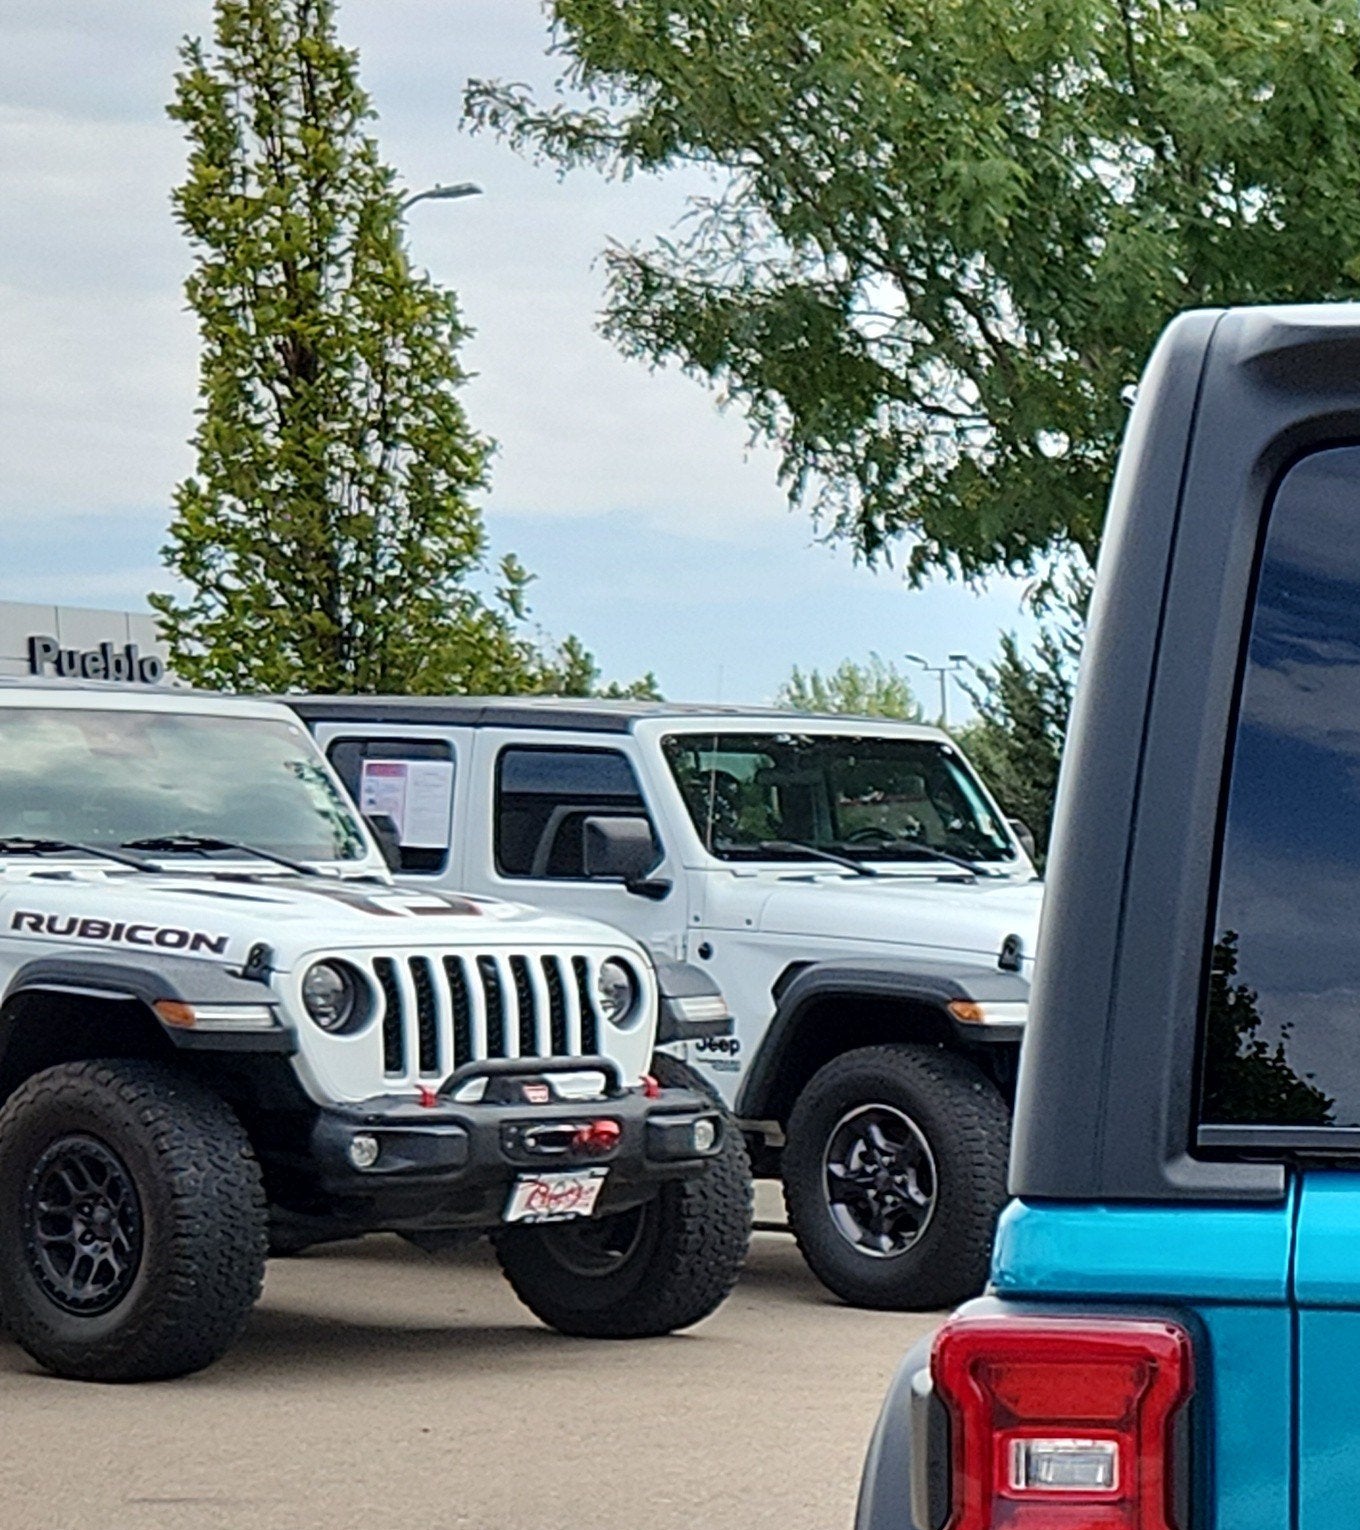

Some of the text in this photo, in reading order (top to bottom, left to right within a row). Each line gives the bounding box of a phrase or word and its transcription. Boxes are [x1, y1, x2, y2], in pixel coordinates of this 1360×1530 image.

[28, 634, 165, 684] Pueblo
[11, 910, 230, 955] RUBICON
[695, 1038, 741, 1058] Jeep
